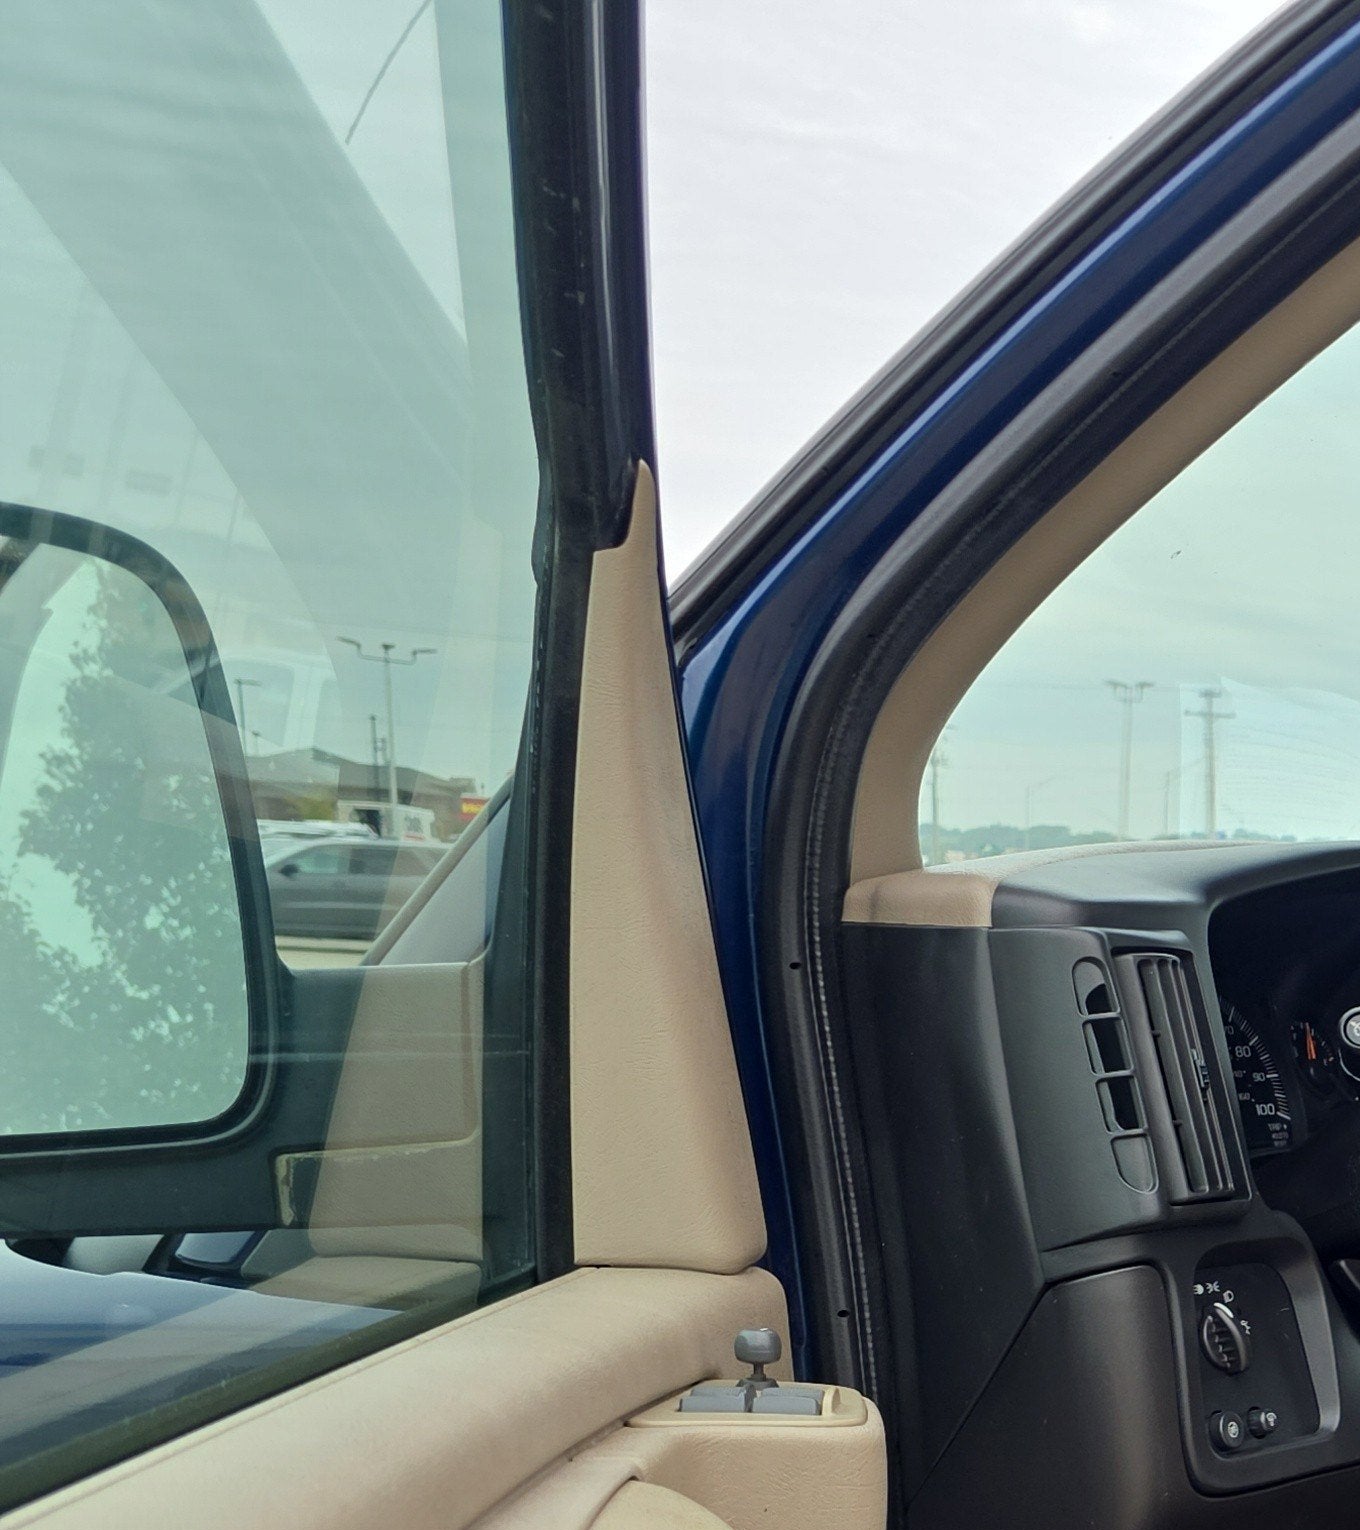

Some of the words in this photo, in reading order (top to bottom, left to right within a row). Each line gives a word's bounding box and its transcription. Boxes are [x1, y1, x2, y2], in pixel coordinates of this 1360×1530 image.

[1235, 1045, 1251, 1058] 80
[1252, 1072, 1265, 1082] 90
[1255, 1103, 1275, 1116] 100
